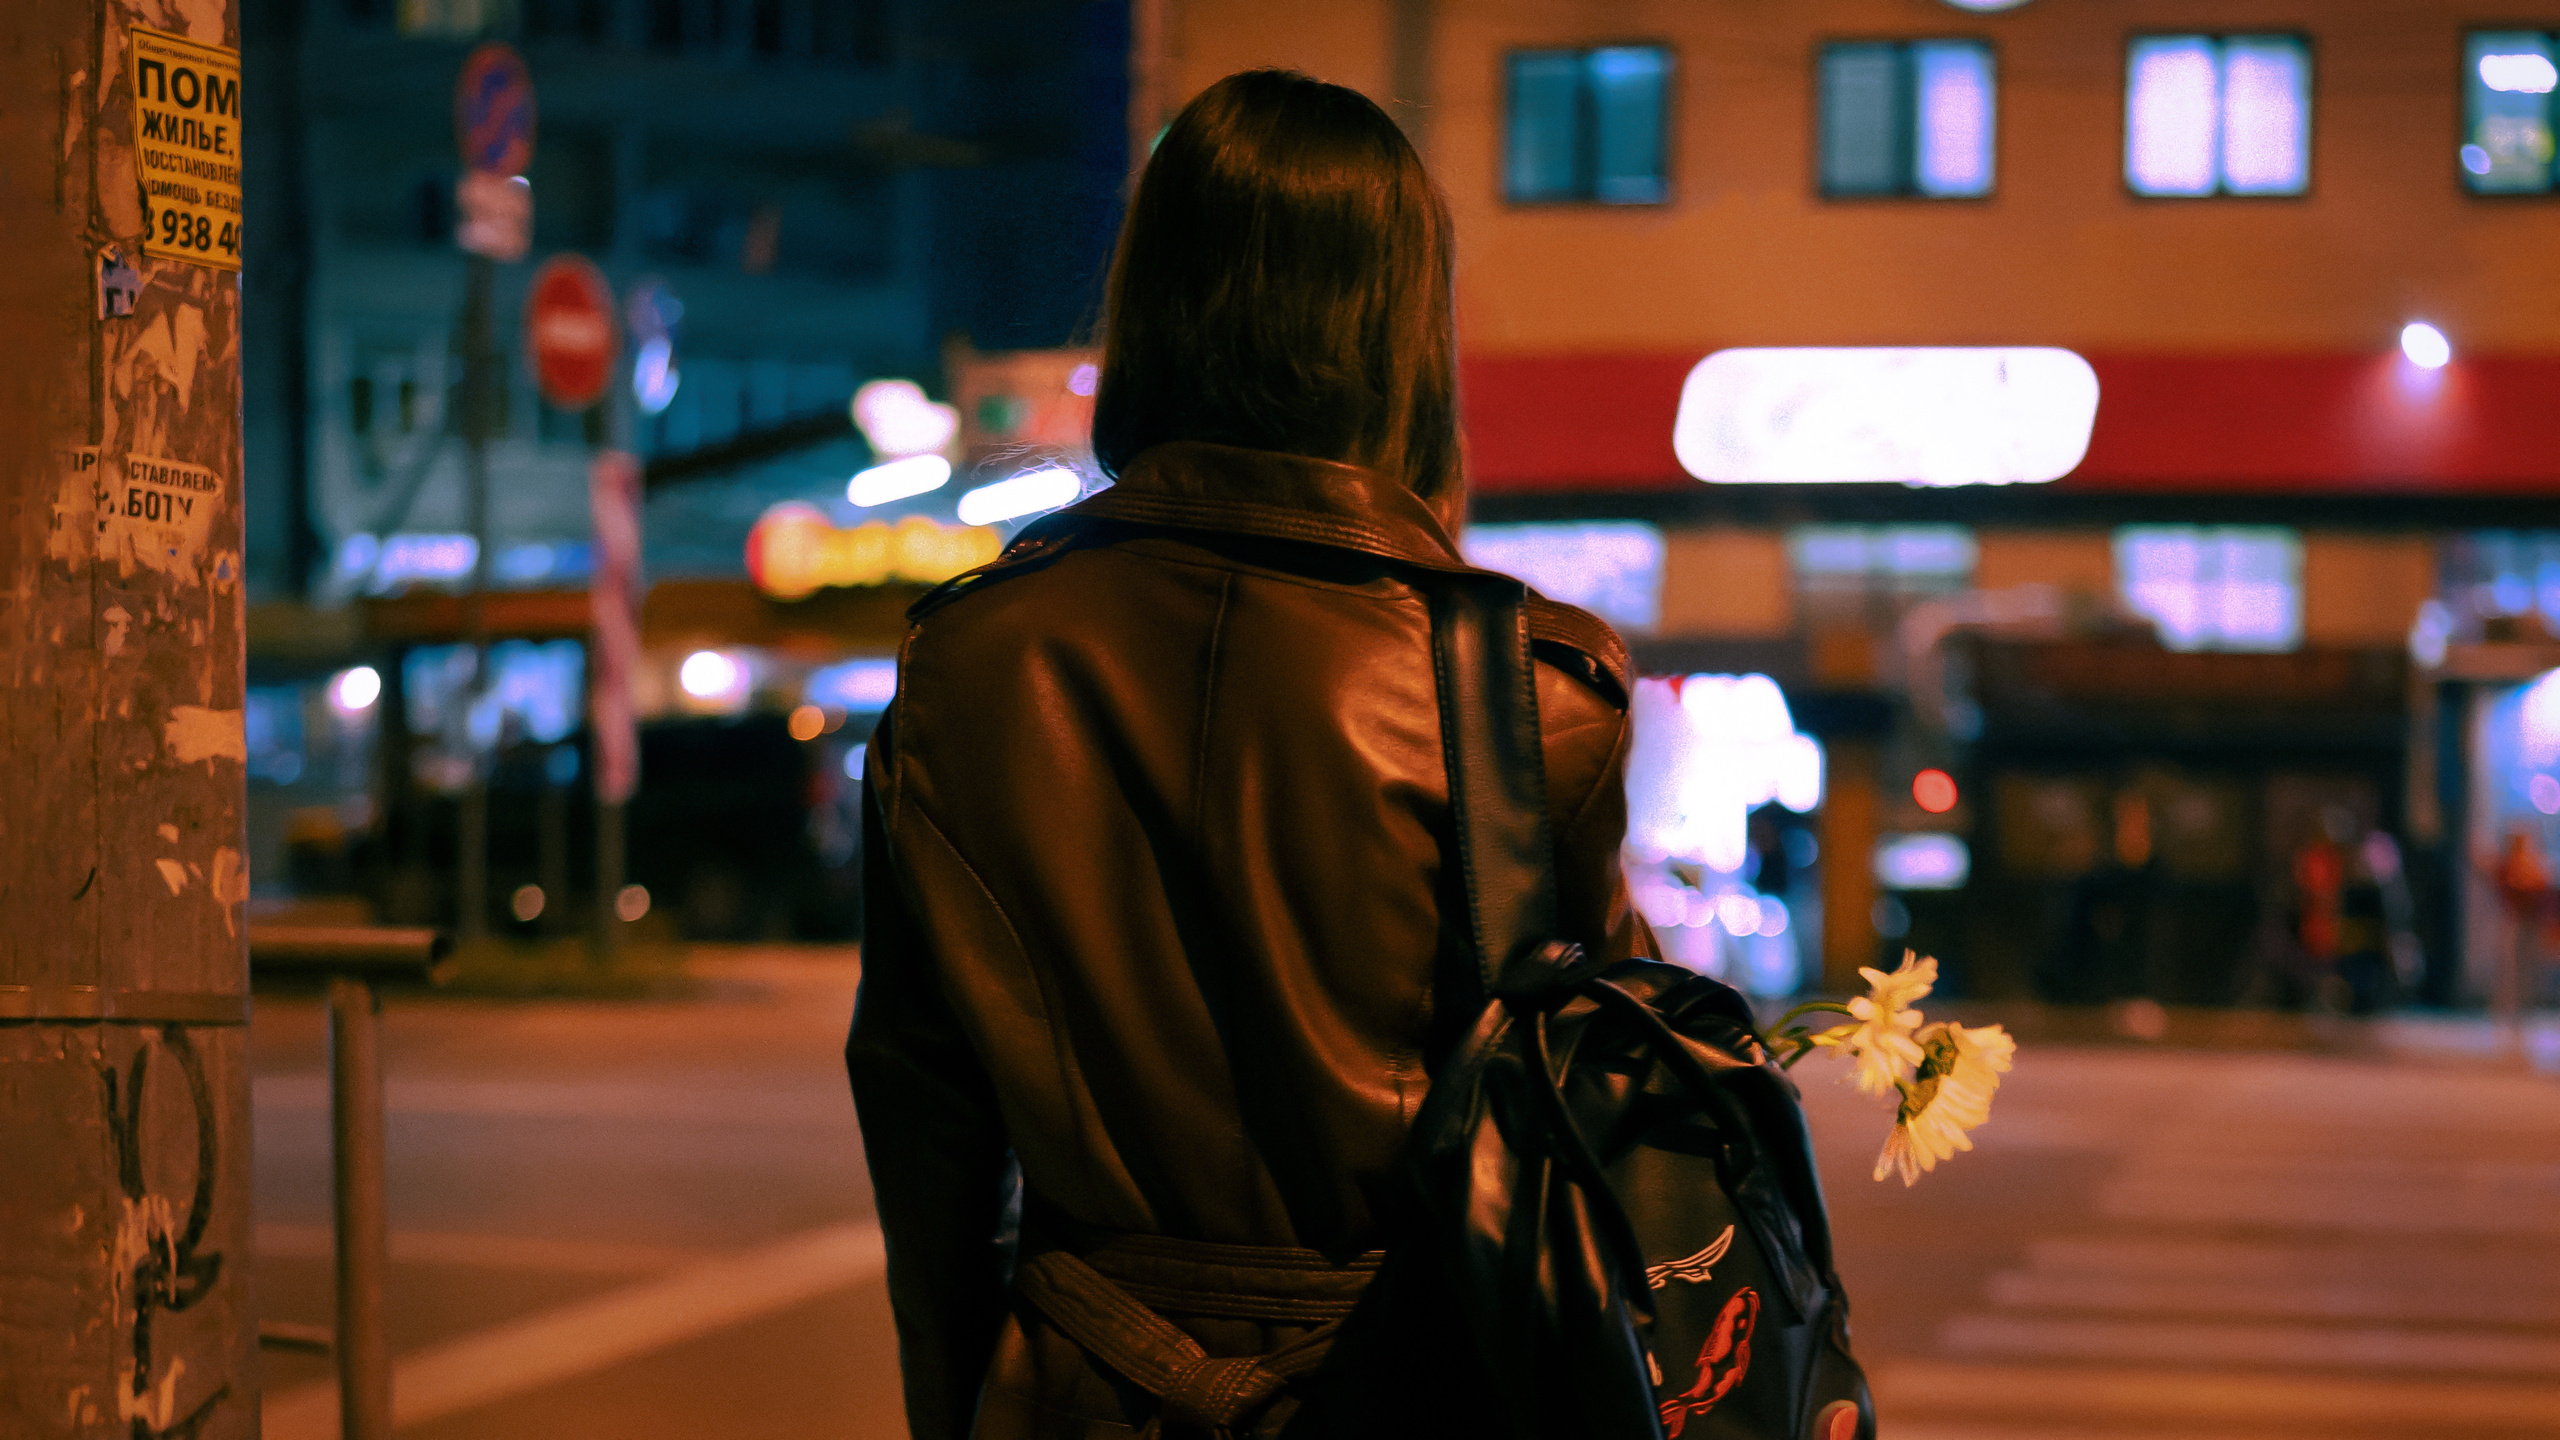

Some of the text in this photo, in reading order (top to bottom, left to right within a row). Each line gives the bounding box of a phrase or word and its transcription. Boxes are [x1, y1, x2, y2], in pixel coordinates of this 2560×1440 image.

[138, 57, 239, 119] ПОМ
[142, 107, 234, 157] ЖИЛЬЕ,
[162, 208, 212, 252] 938
